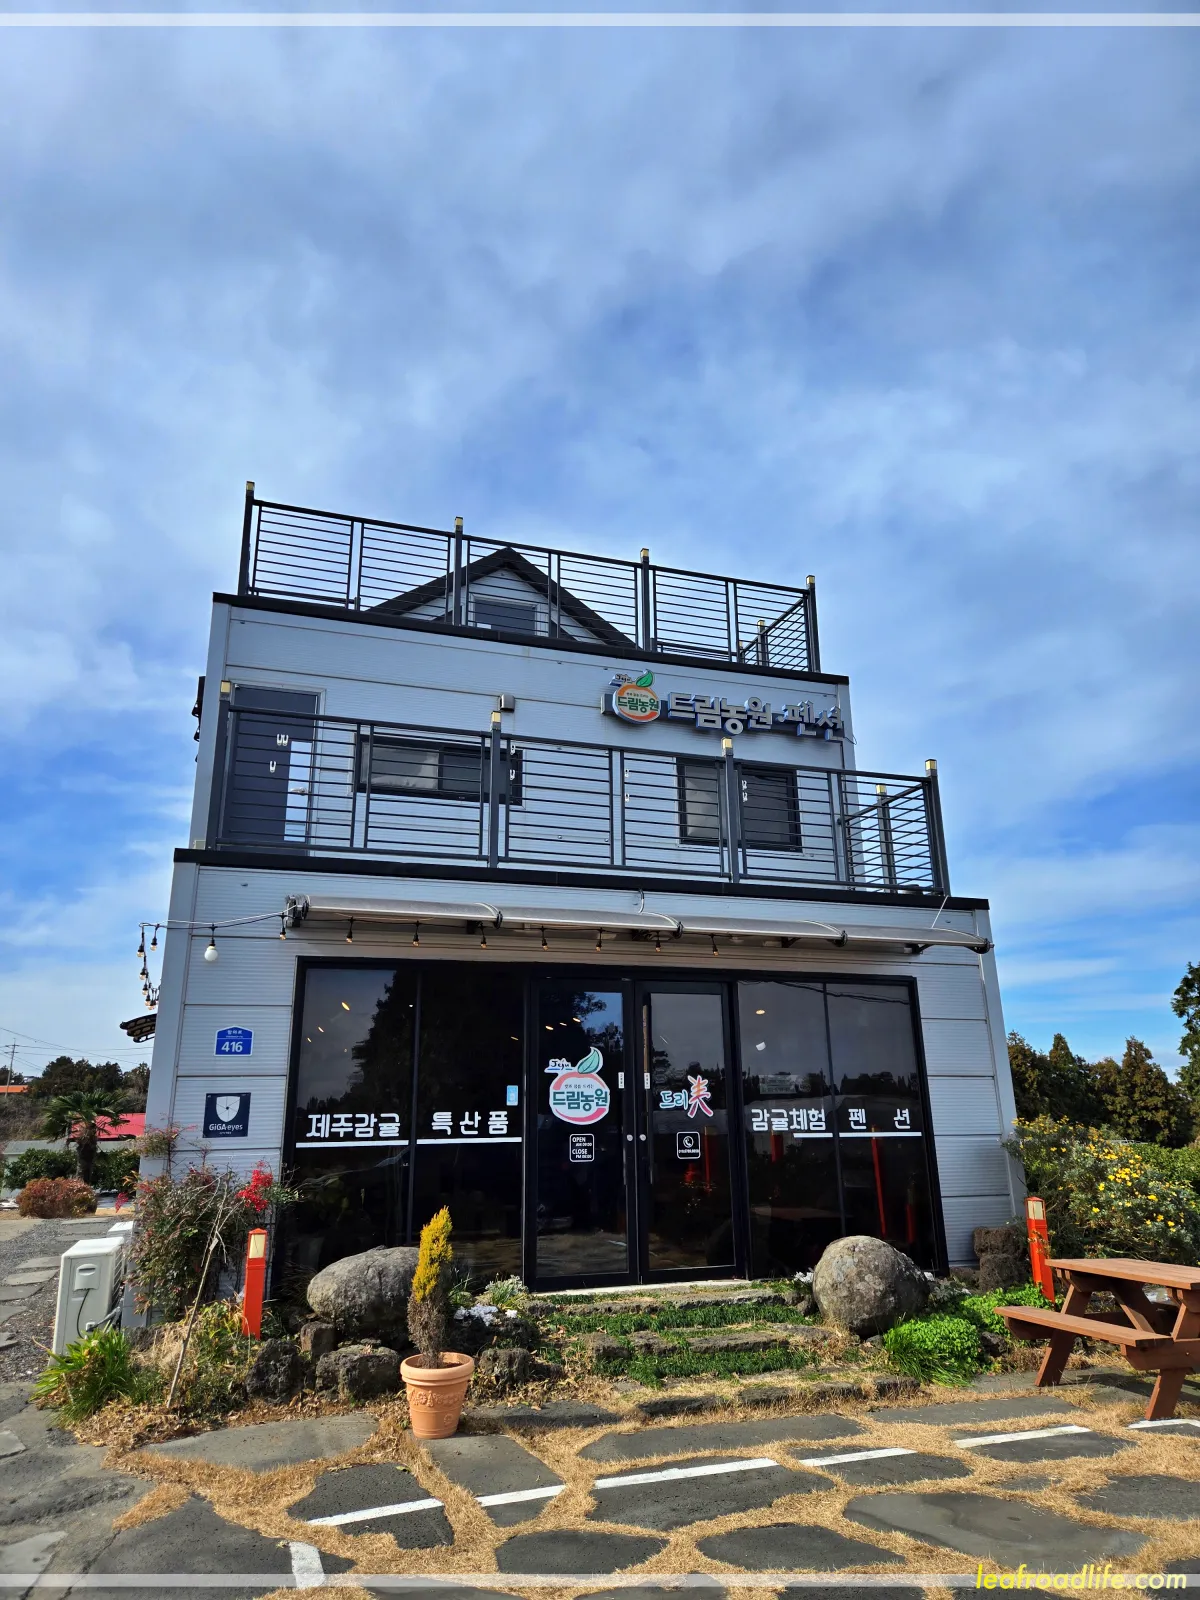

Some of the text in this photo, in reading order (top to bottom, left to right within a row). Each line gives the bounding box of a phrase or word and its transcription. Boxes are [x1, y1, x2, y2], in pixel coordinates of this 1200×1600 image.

[617, 696, 659, 713] 드림농원
[668, 692, 844, 742] 드림농원 펜션
[221, 1041, 244, 1053] 416
[550, 1060, 570, 1070] Jeju
[552, 1088, 608, 1112] 드림농원
[305, 1113, 401, 1138] 제주감귤
[751, 1108, 826, 1131] 감귤체험
